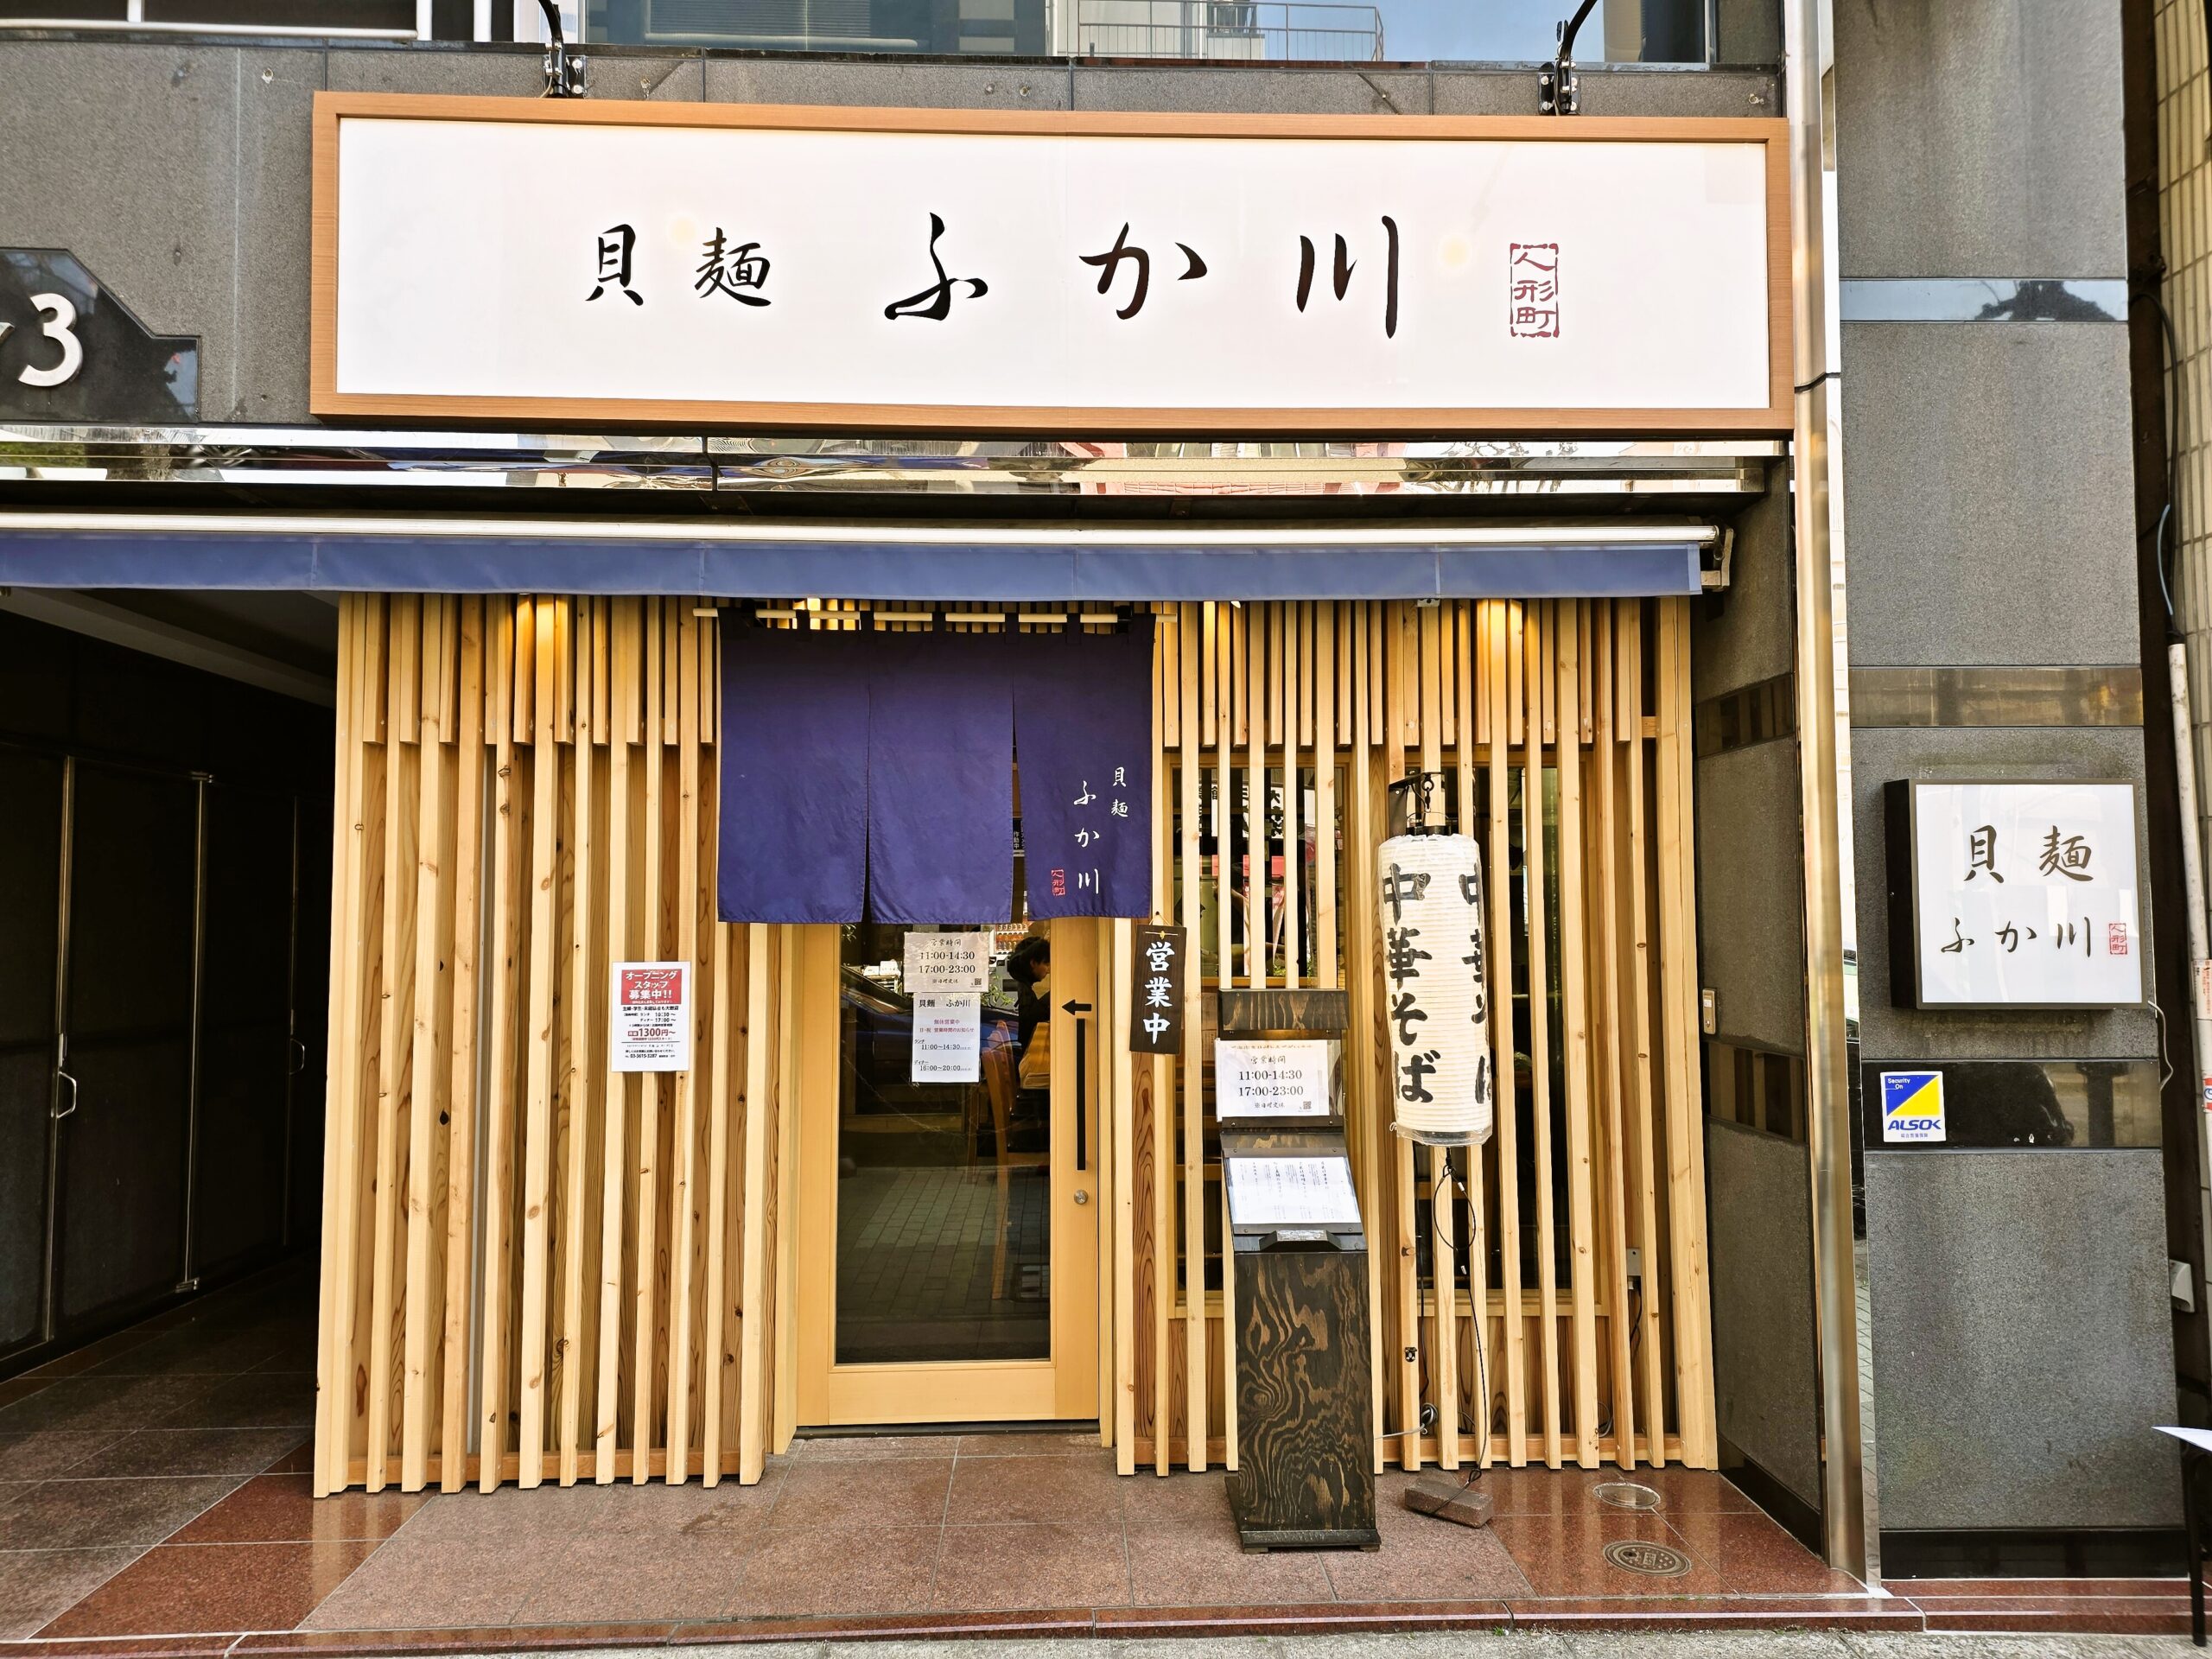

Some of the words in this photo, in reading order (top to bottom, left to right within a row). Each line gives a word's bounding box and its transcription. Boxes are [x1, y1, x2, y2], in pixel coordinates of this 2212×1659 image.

[585, 223, 772, 308] 貝麺
[884, 212, 1399, 339] ふか川
[1513, 251, 1556, 329] 人形町
[1110, 766, 1128, 817] 貝麺
[1073, 780, 1100, 894] ふか川
[1963, 824, 2094, 884] 貝麺
[1941, 916, 2091, 957] ふか川
[2110, 925, 2126, 953] 人形町
[918, 965, 976, 974] 17:00-23:00
[919, 951, 976, 960] 11:00-14:30
[626, 971, 677, 980] オープニング
[634, 981, 669, 989] スタッフ
[1382, 862, 1441, 1103] 中華そば
[946, 999, 970, 1007] ふか川
[1142, 941, 1175, 1045] 営業中
[1238, 1070, 1303, 1081] 11:00-14:30
[1238, 1085, 1304, 1097] 17:00-23:00
[1887, 1119, 1942, 1131] ALSOK
